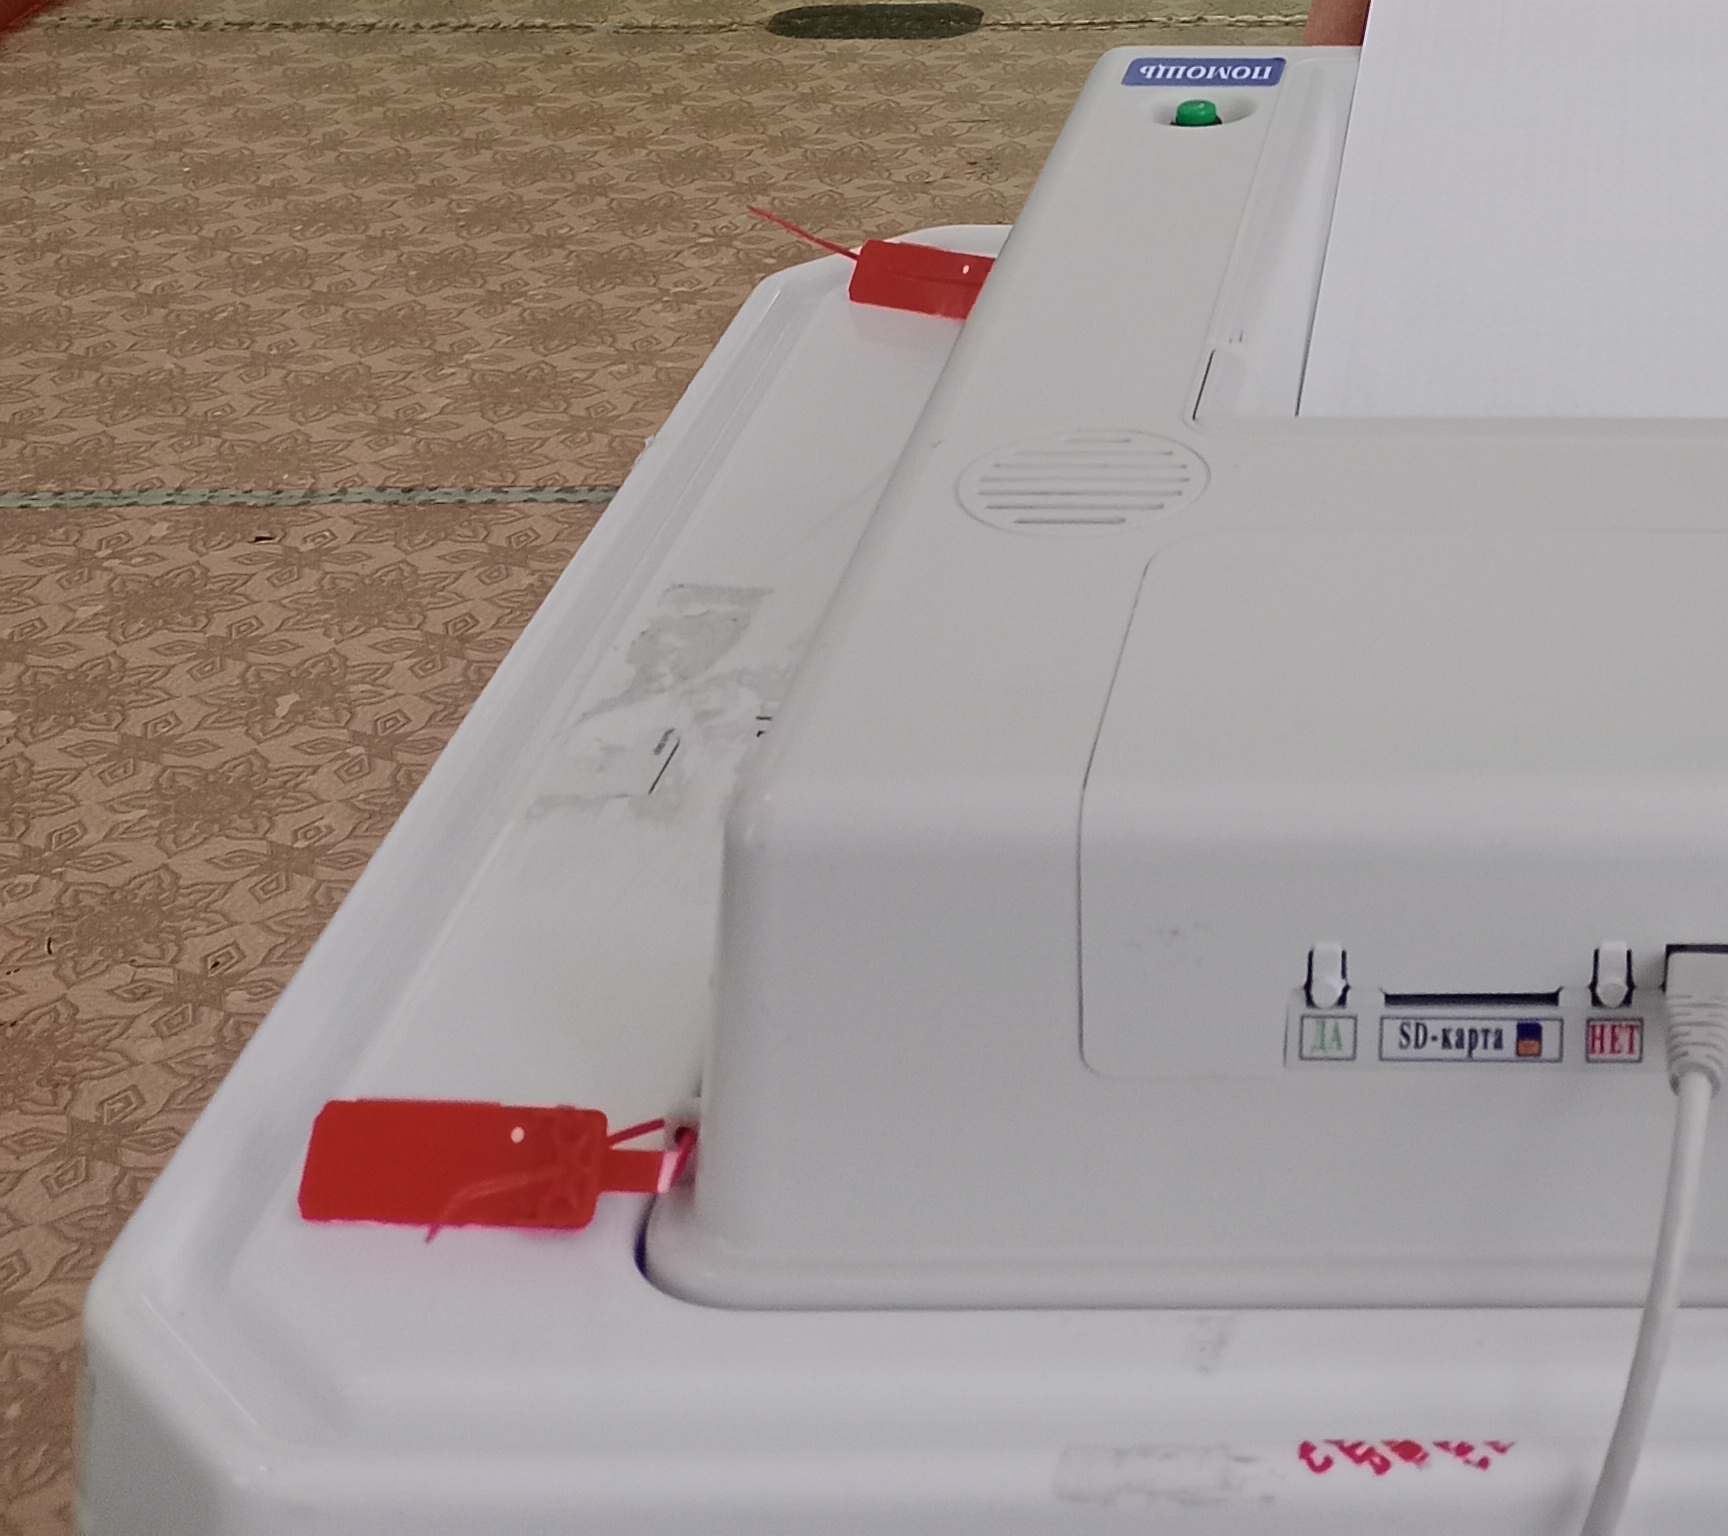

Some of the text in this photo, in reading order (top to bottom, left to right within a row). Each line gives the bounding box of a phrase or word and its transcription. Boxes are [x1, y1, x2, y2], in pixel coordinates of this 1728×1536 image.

[1139, 64, 1273, 80] ПОМОЩЬ
[1311, 1020, 1344, 1053] ДА
[1399, 1020, 1505, 1059] SD-карта
[1588, 1022, 1640, 1056] НЕТ
